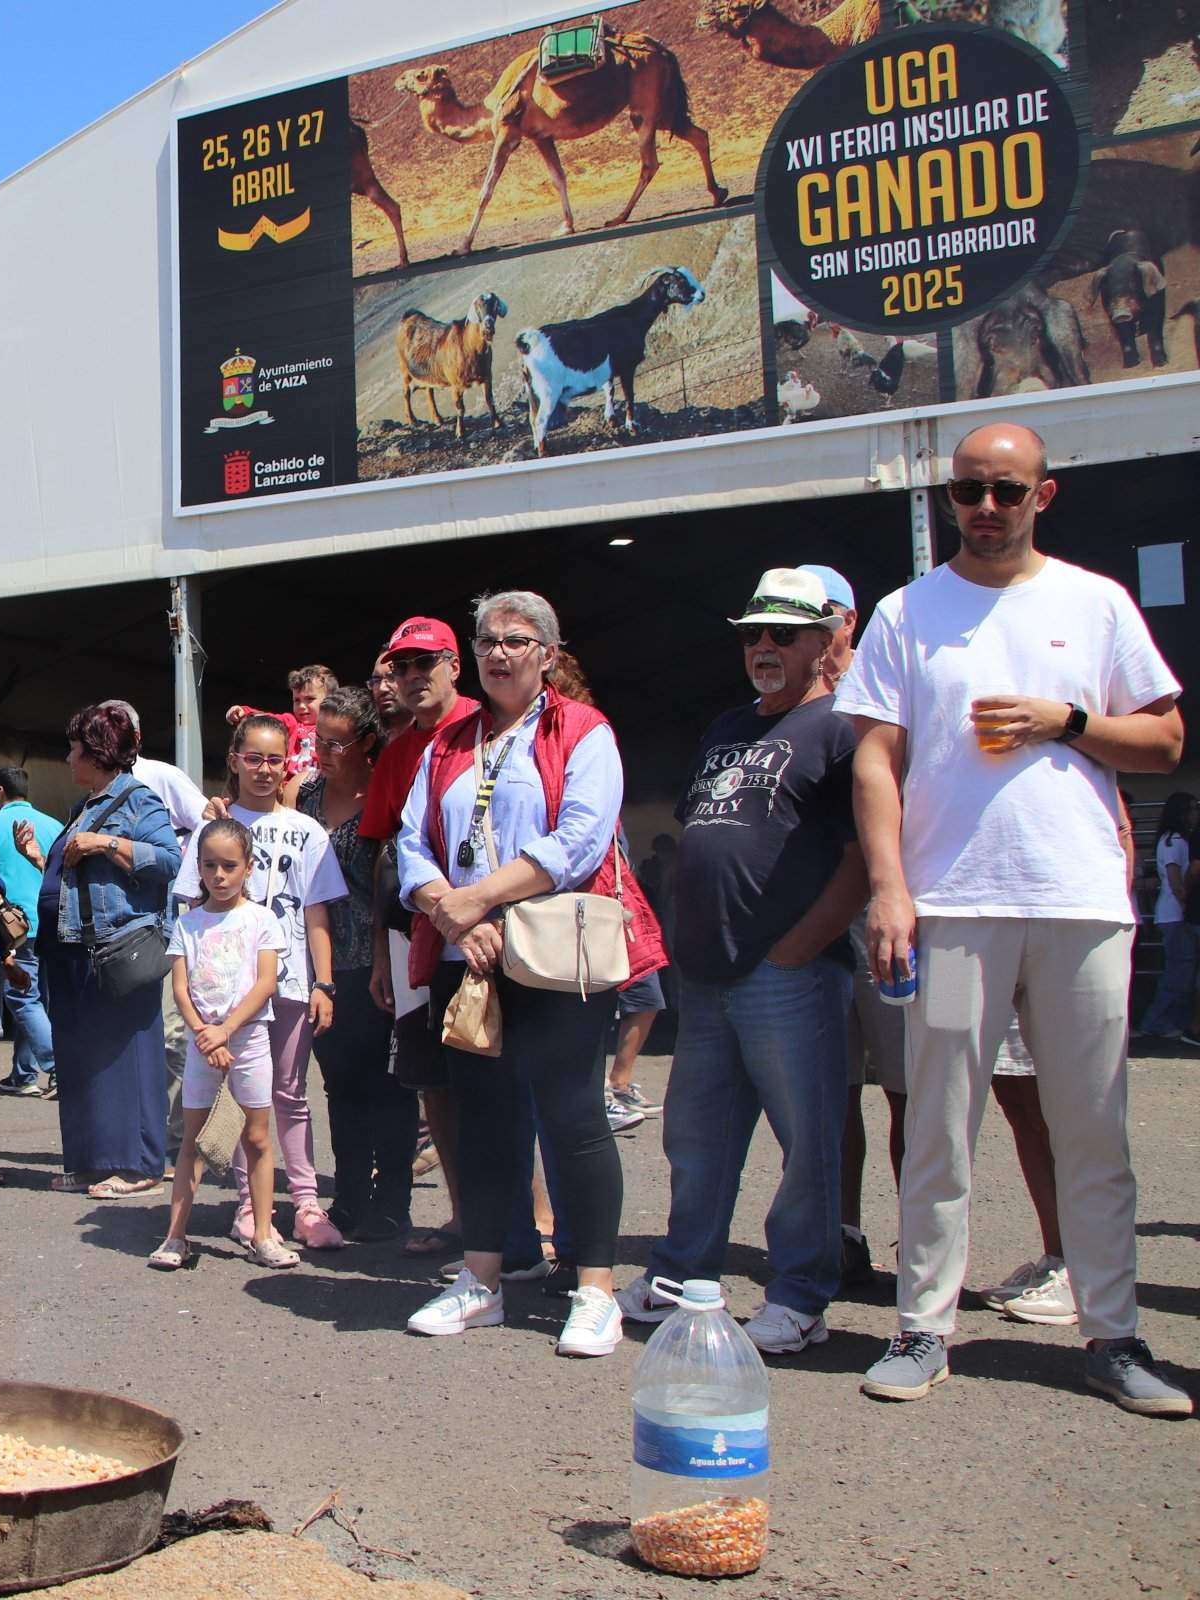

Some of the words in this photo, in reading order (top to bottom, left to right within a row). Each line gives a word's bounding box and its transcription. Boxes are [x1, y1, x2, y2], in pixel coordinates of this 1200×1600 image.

[864, 43, 959, 116] UGA
[202, 134, 236, 171] 25,
[242, 124, 270, 161] 26
[277, 118, 291, 151] Y
[297, 110, 324, 147] 27
[786, 136, 822, 171] XVI
[830, 121, 896, 162] FERIA
[903, 97, 1008, 148] INSULAR
[1016, 89, 1049, 126] DE
[232, 162, 295, 207] ABRIL
[796, 131, 1045, 247] GANADO
[810, 250, 848, 280] SAN
[854, 238, 921, 273] ISIDRO
[927, 217, 1036, 262] LABRADOR
[881, 264, 964, 316] 2025
[258, 357, 333, 379] Ayuntamiento
[258, 381, 271, 392] de
[274, 375, 307, 390] YAIZA
[254, 456, 305, 475] Cabildo
[308, 454, 325, 467] de
[254, 469, 320, 488] Lanzarote
[702, 749, 775, 775] ROMA
[694, 798, 743, 815] ITALY
